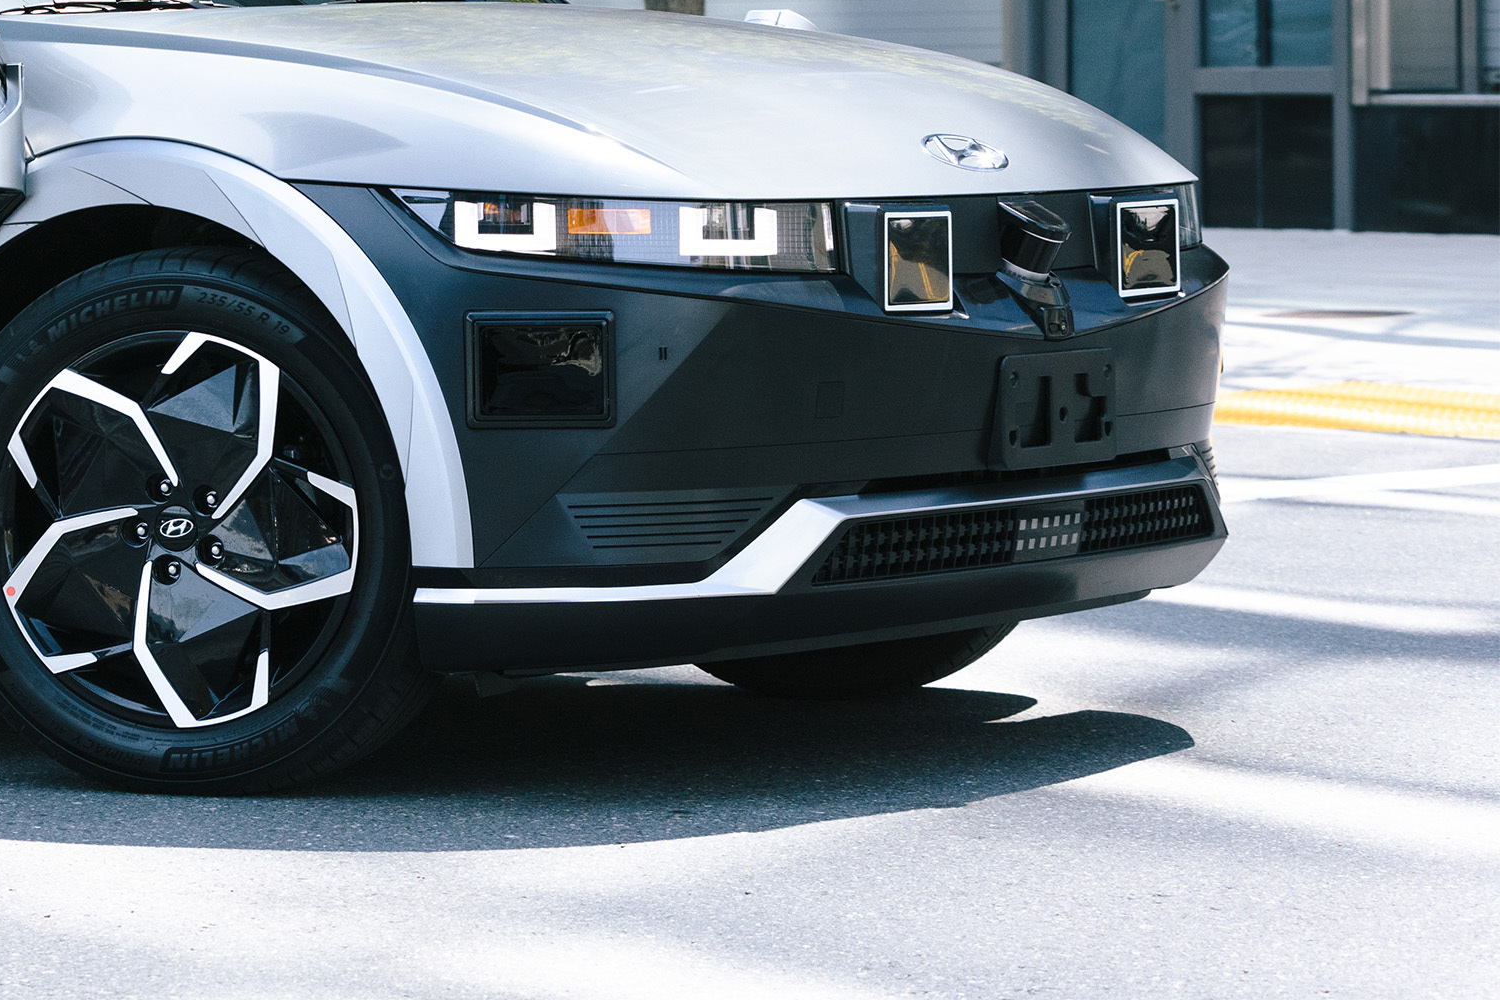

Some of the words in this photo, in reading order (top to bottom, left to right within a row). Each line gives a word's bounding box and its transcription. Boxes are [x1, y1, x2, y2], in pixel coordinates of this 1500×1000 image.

[47, 289, 175, 343] MICHELIN
[196, 291, 256, 317] 235/55
[256, 311, 271, 324] R
[273, 320, 291, 335] 19
[71, 733, 146, 767] PRIMACY
[168, 716, 301, 768] MICHELIN
